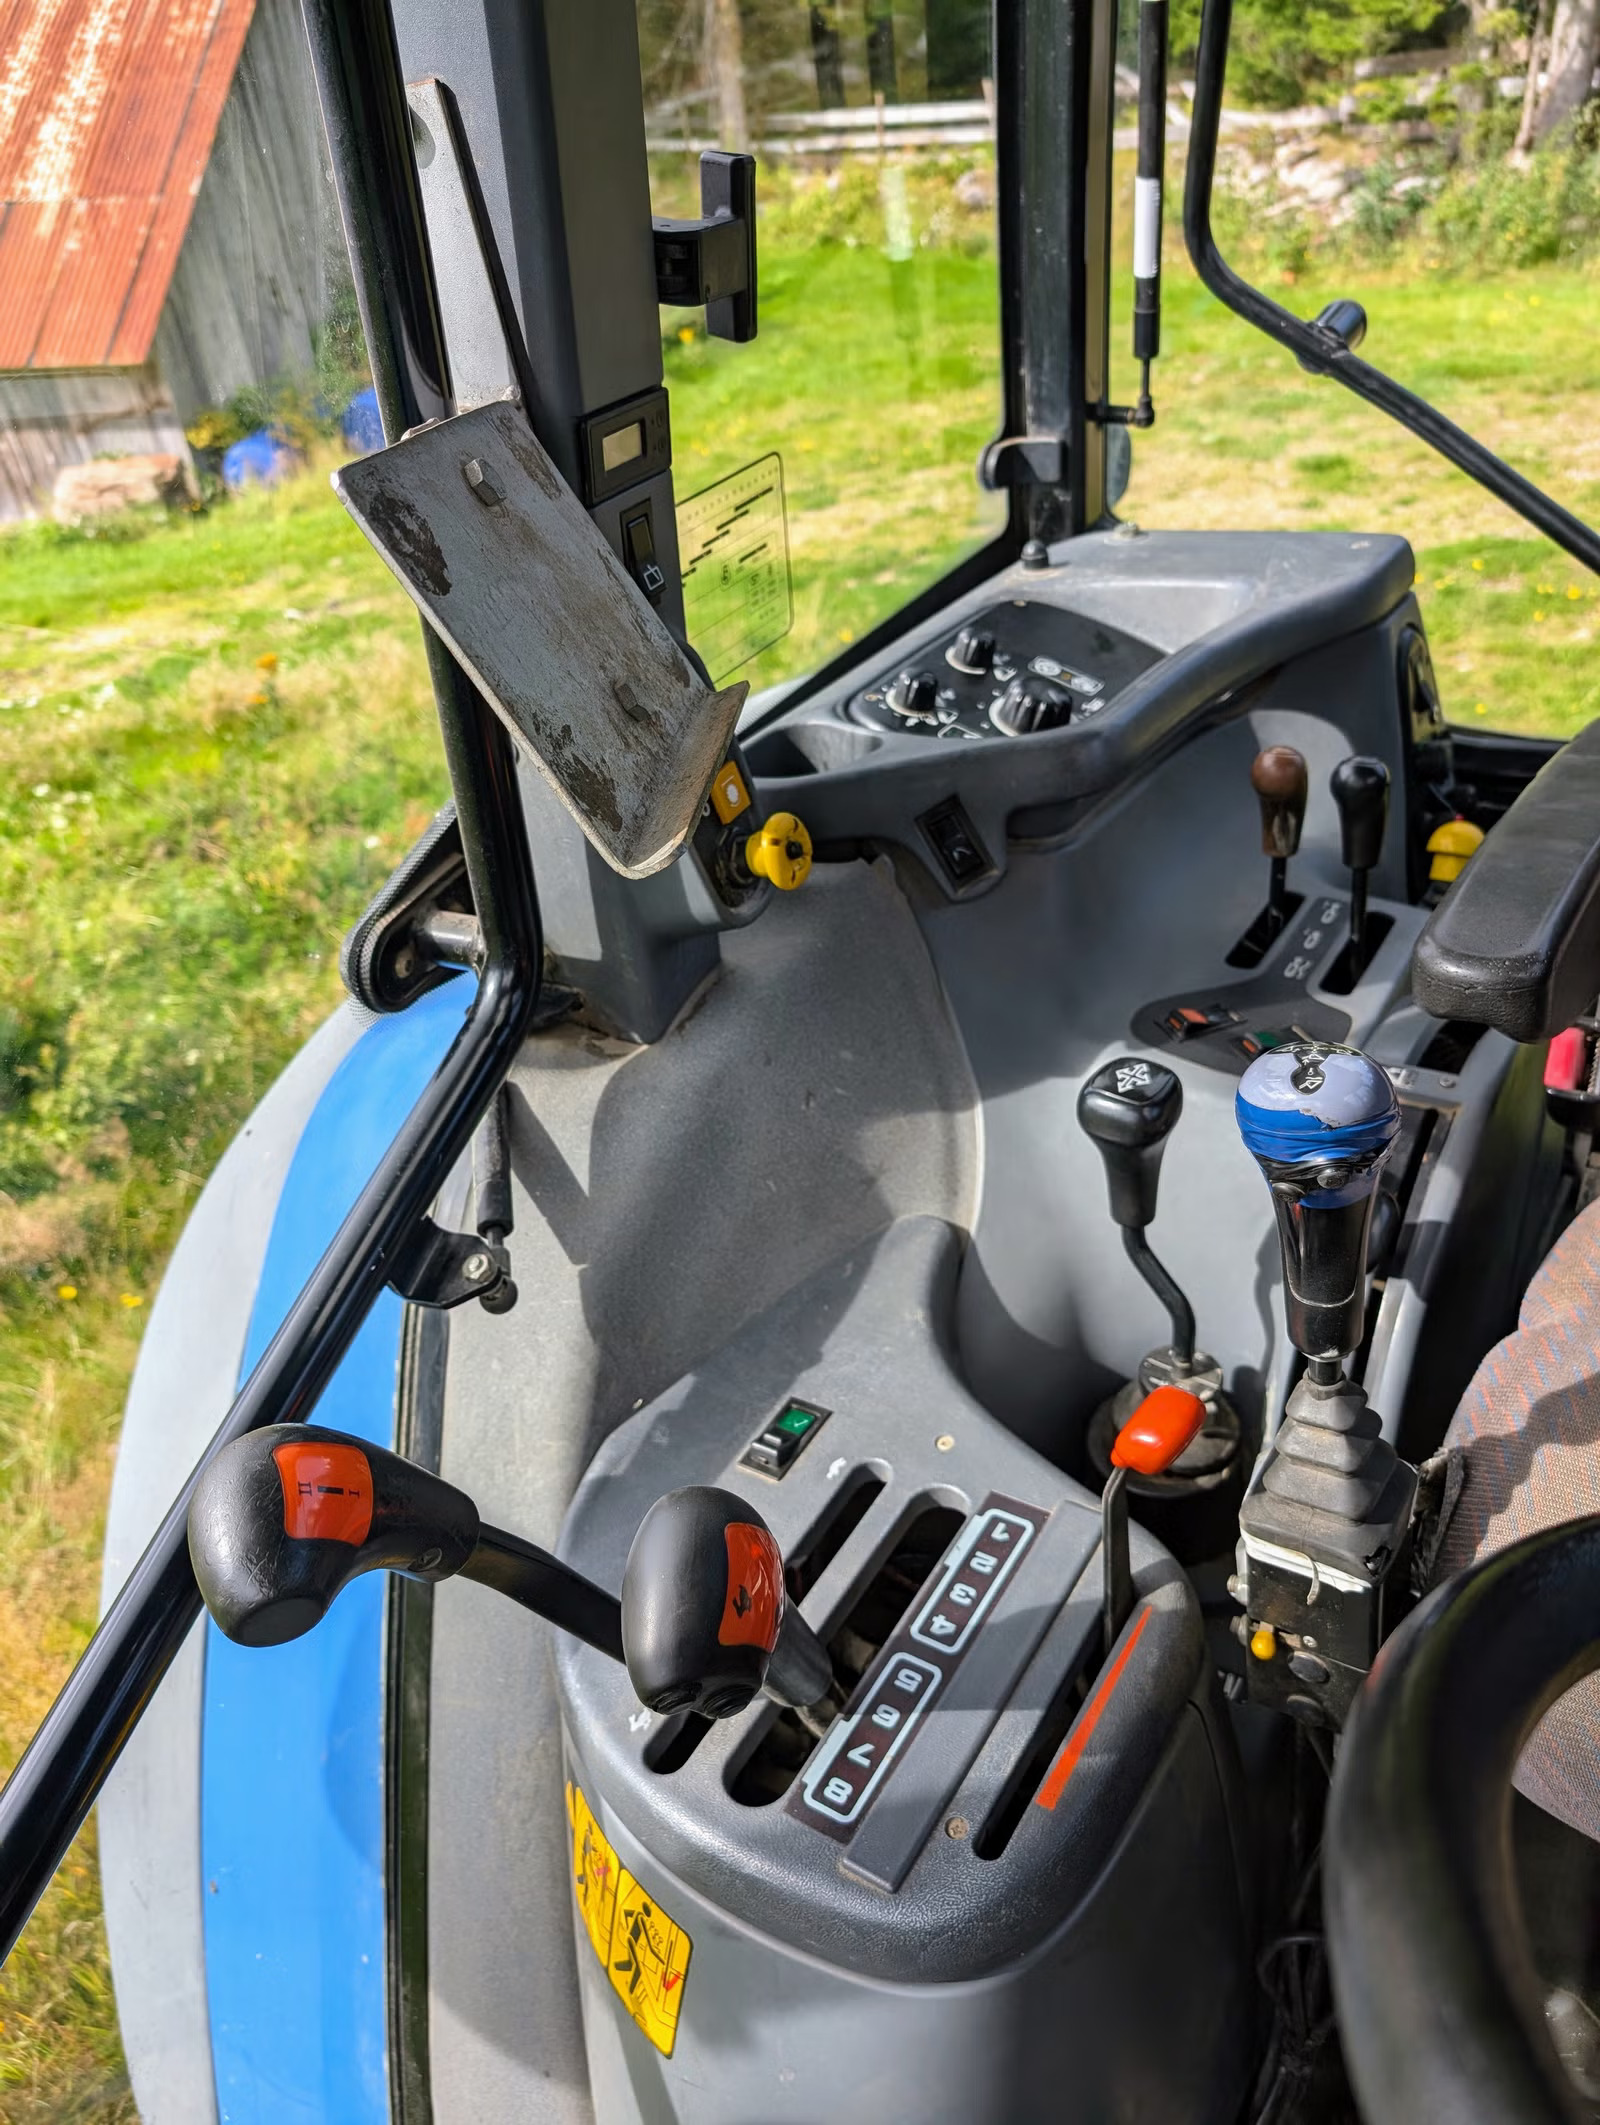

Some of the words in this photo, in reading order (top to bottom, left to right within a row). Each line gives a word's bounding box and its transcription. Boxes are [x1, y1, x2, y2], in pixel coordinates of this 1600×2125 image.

[990, 1522, 1010, 1542] 1
[969, 1551, 998, 1575] 2
[949, 1582, 977, 1606] 3
[929, 1614, 957, 1636] 4
[894, 1668, 923, 1693] 5
[871, 1704, 901, 1728] 6
[846, 1743, 876, 1767] 7
[823, 1777, 853, 1804] 8
